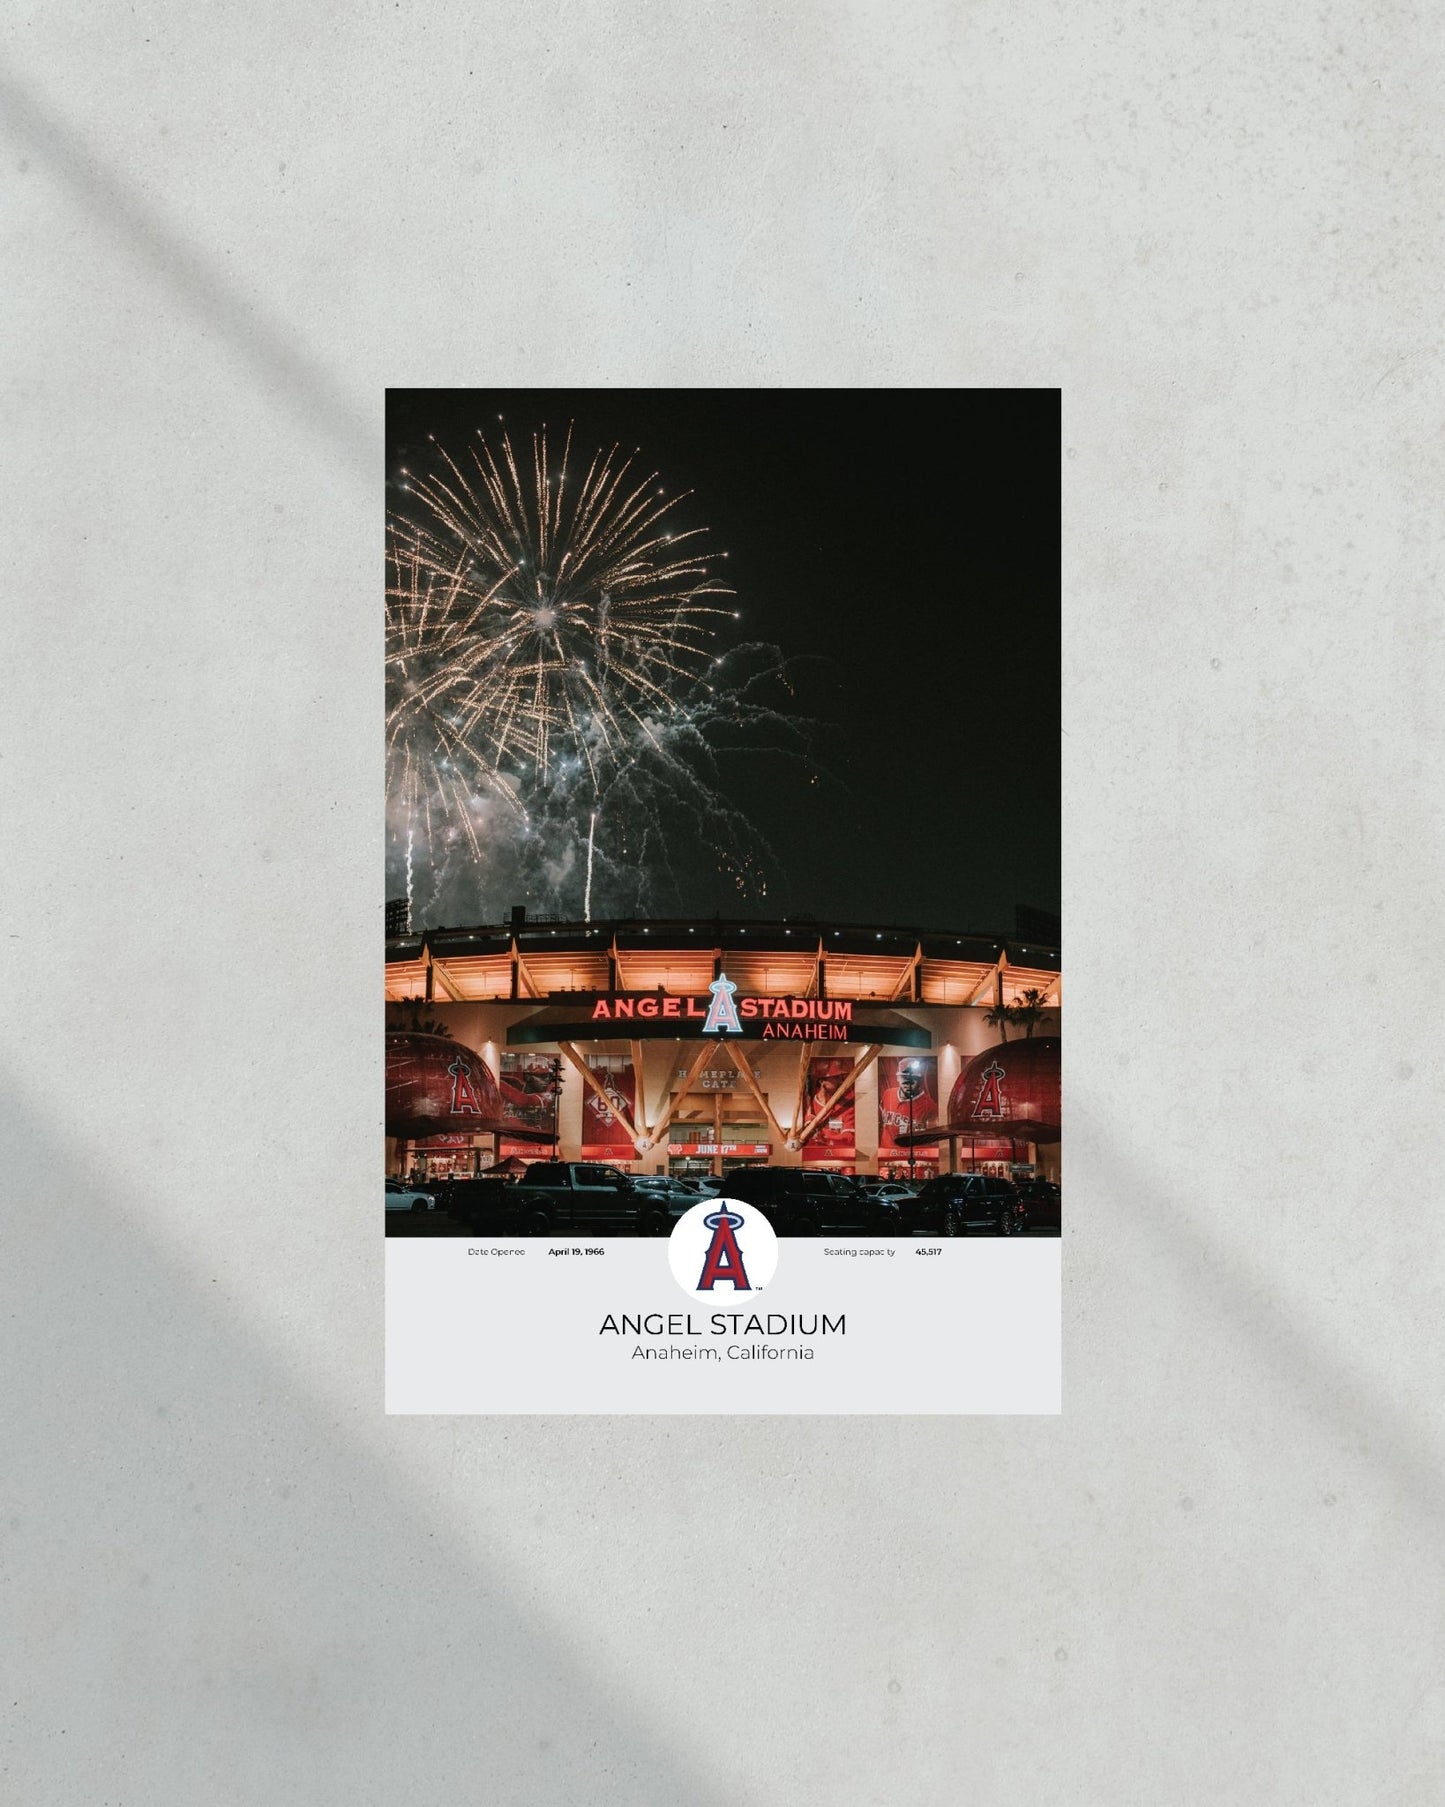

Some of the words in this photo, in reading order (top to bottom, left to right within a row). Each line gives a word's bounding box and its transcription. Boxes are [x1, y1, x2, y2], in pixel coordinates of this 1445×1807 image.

[592, 997, 706, 1019] ANGEL
[702, 973, 743, 1032] A
[740, 998, 852, 1021] STADIUM
[762, 1022, 847, 1040] ANAHEIM
[678, 1070, 761, 1079] HMEPLAE
[448, 1056, 482, 1115] A
[702, 1080, 737, 1089] GATE
[971, 1060, 1006, 1118] A
[695, 1144, 718, 1154] JUNE
[467, 1247, 489, 1256] Date
[548, 1247, 570, 1258] April
[571, 1247, 583, 1257] 19,
[584, 1247, 605, 1256] 1966
[696, 1200, 752, 1291] A
[823, 1247, 858, 1258] Seating
[859, 1247, 896, 1258] capacty
[915, 1247, 943, 1257] 45,517
[598, 1313, 703, 1336] ANGEL
[710, 1313, 846, 1336] STADIUM
[631, 1344, 722, 1363] Anaheim,
[726, 1344, 814, 1360] California
